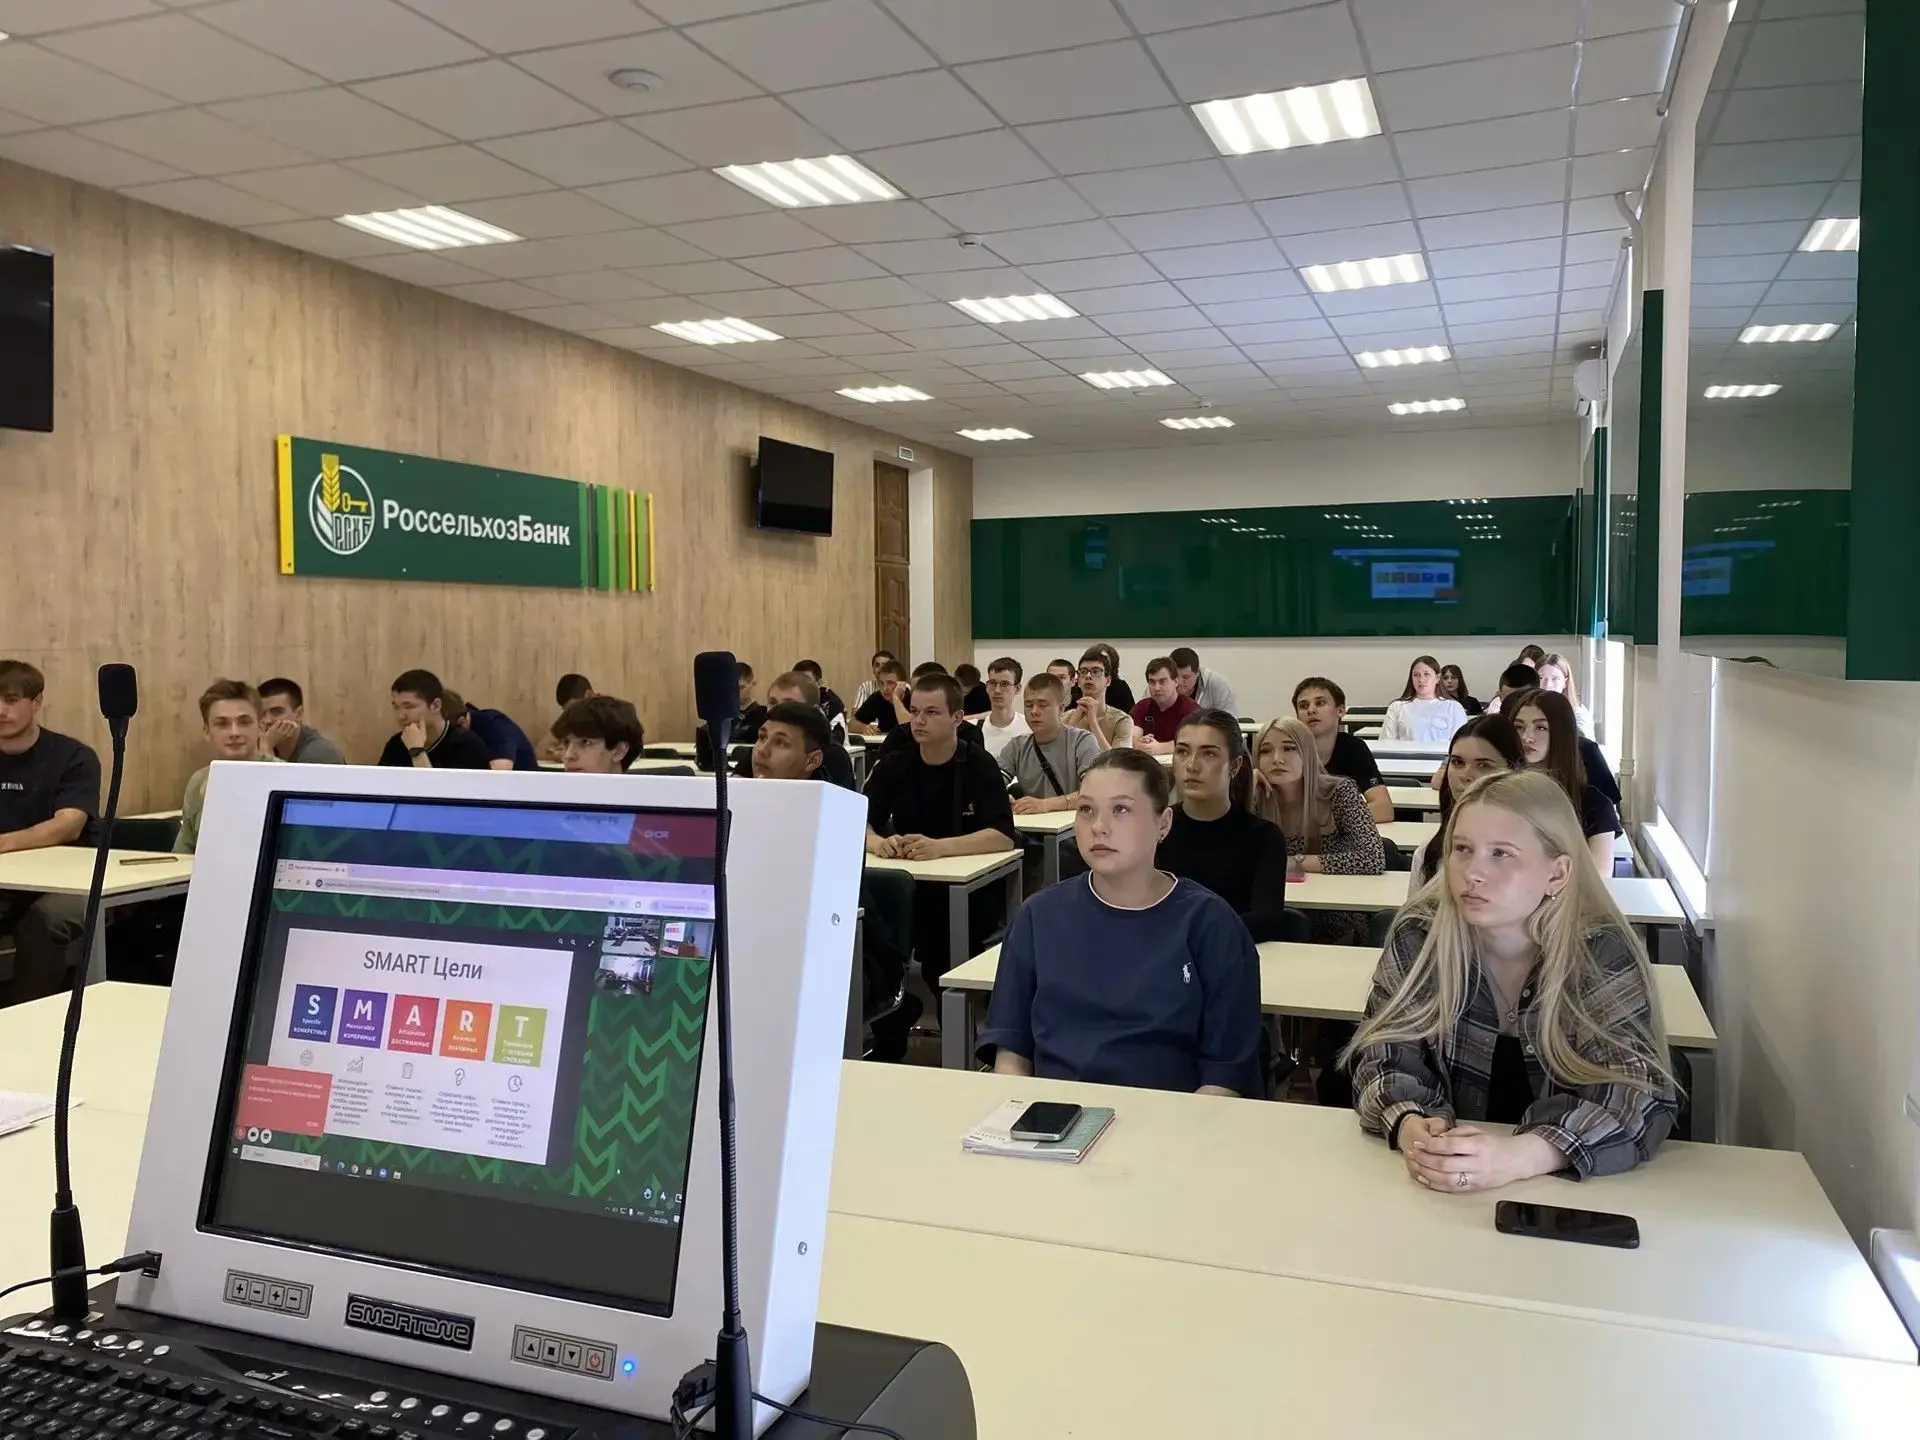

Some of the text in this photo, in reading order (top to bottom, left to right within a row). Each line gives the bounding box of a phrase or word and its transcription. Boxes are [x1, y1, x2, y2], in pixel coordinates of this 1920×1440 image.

[383, 499, 571, 546] РоссельхозБанк
[363, 950, 483, 980] SMART Цели
[307, 994, 321, 1016] S
[353, 999, 373, 1021] M
[405, 1004, 421, 1027] A
[459, 1009, 474, 1033] R
[514, 1015, 529, 1038] T
